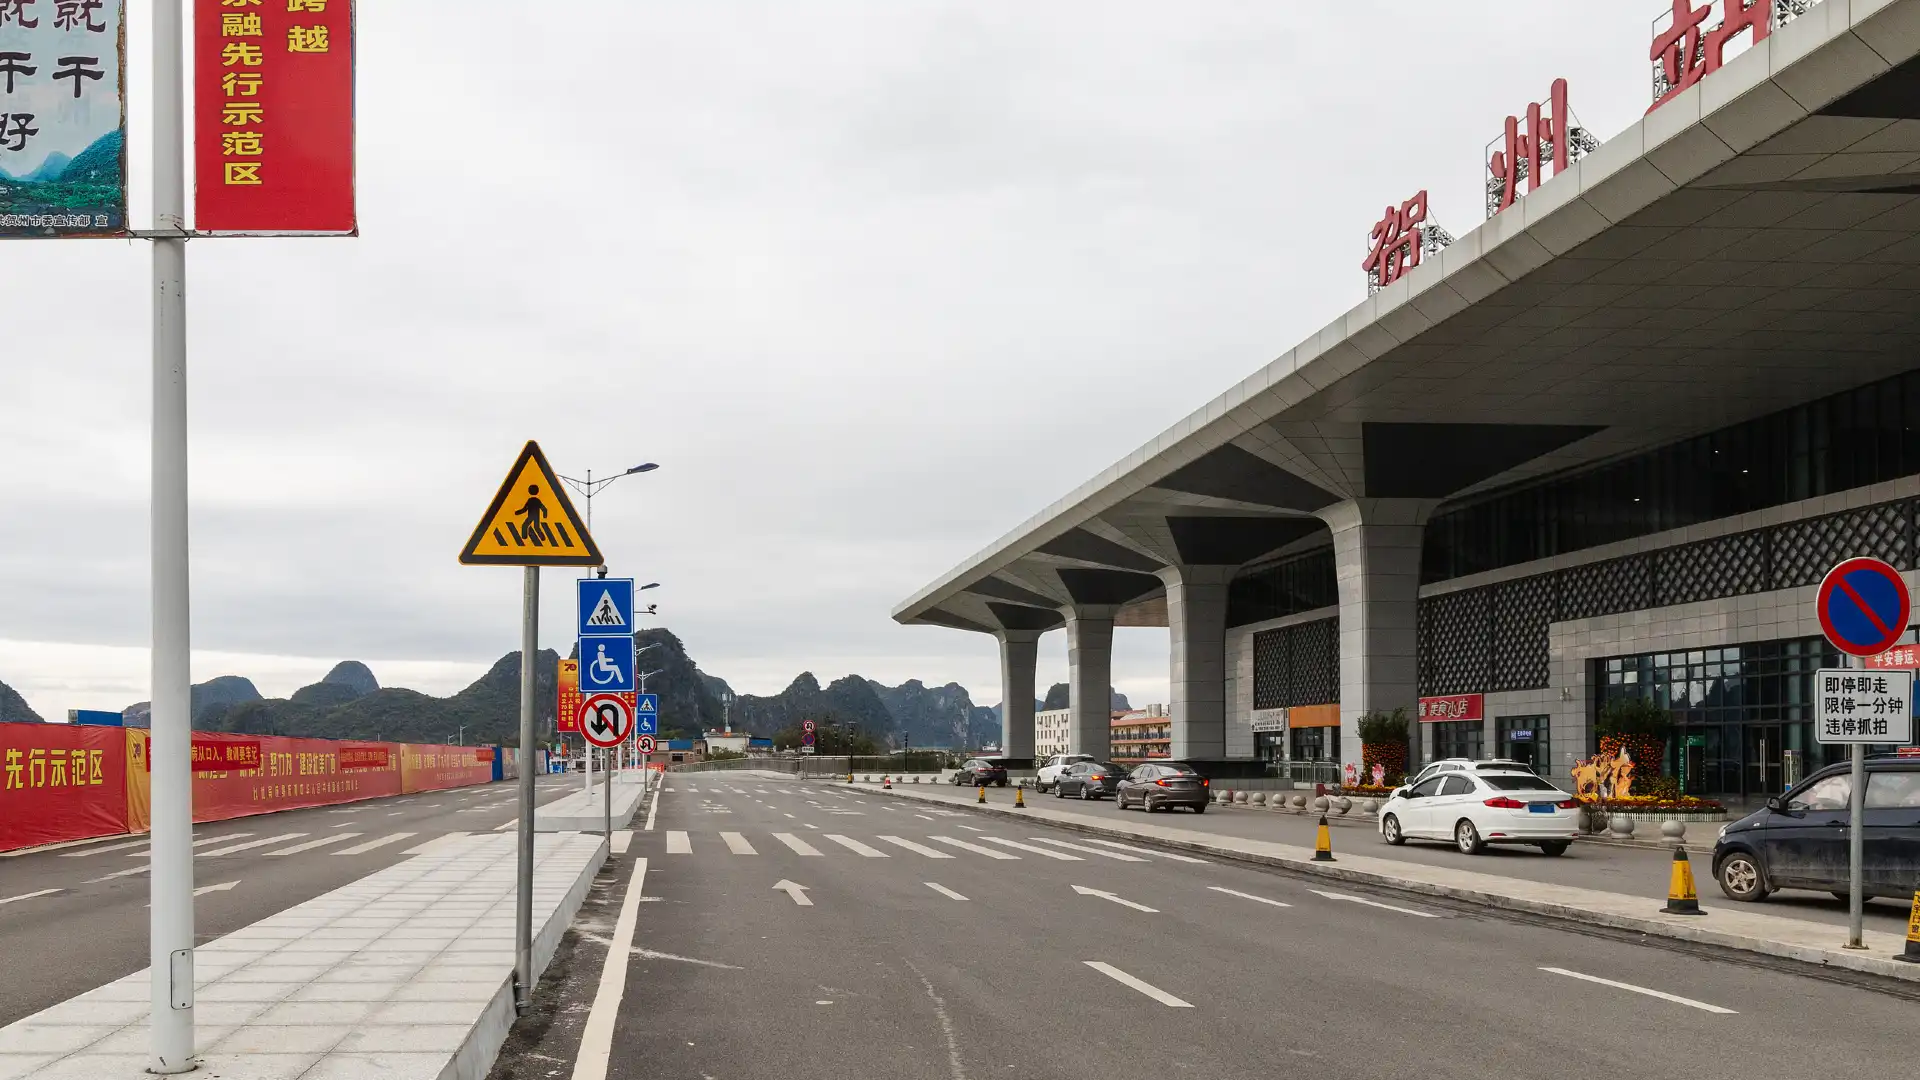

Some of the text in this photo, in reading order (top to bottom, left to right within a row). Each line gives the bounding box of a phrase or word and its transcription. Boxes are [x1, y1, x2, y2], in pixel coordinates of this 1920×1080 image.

[221, 0, 264, 185] 融先行示范区
[1825, 676, 1888, 694] 即停即走
[1824, 697, 1903, 715] 限停一分钟
[1825, 717, 1888, 736] 违停抓拍
[5, 748, 104, 790] 先行示范区
